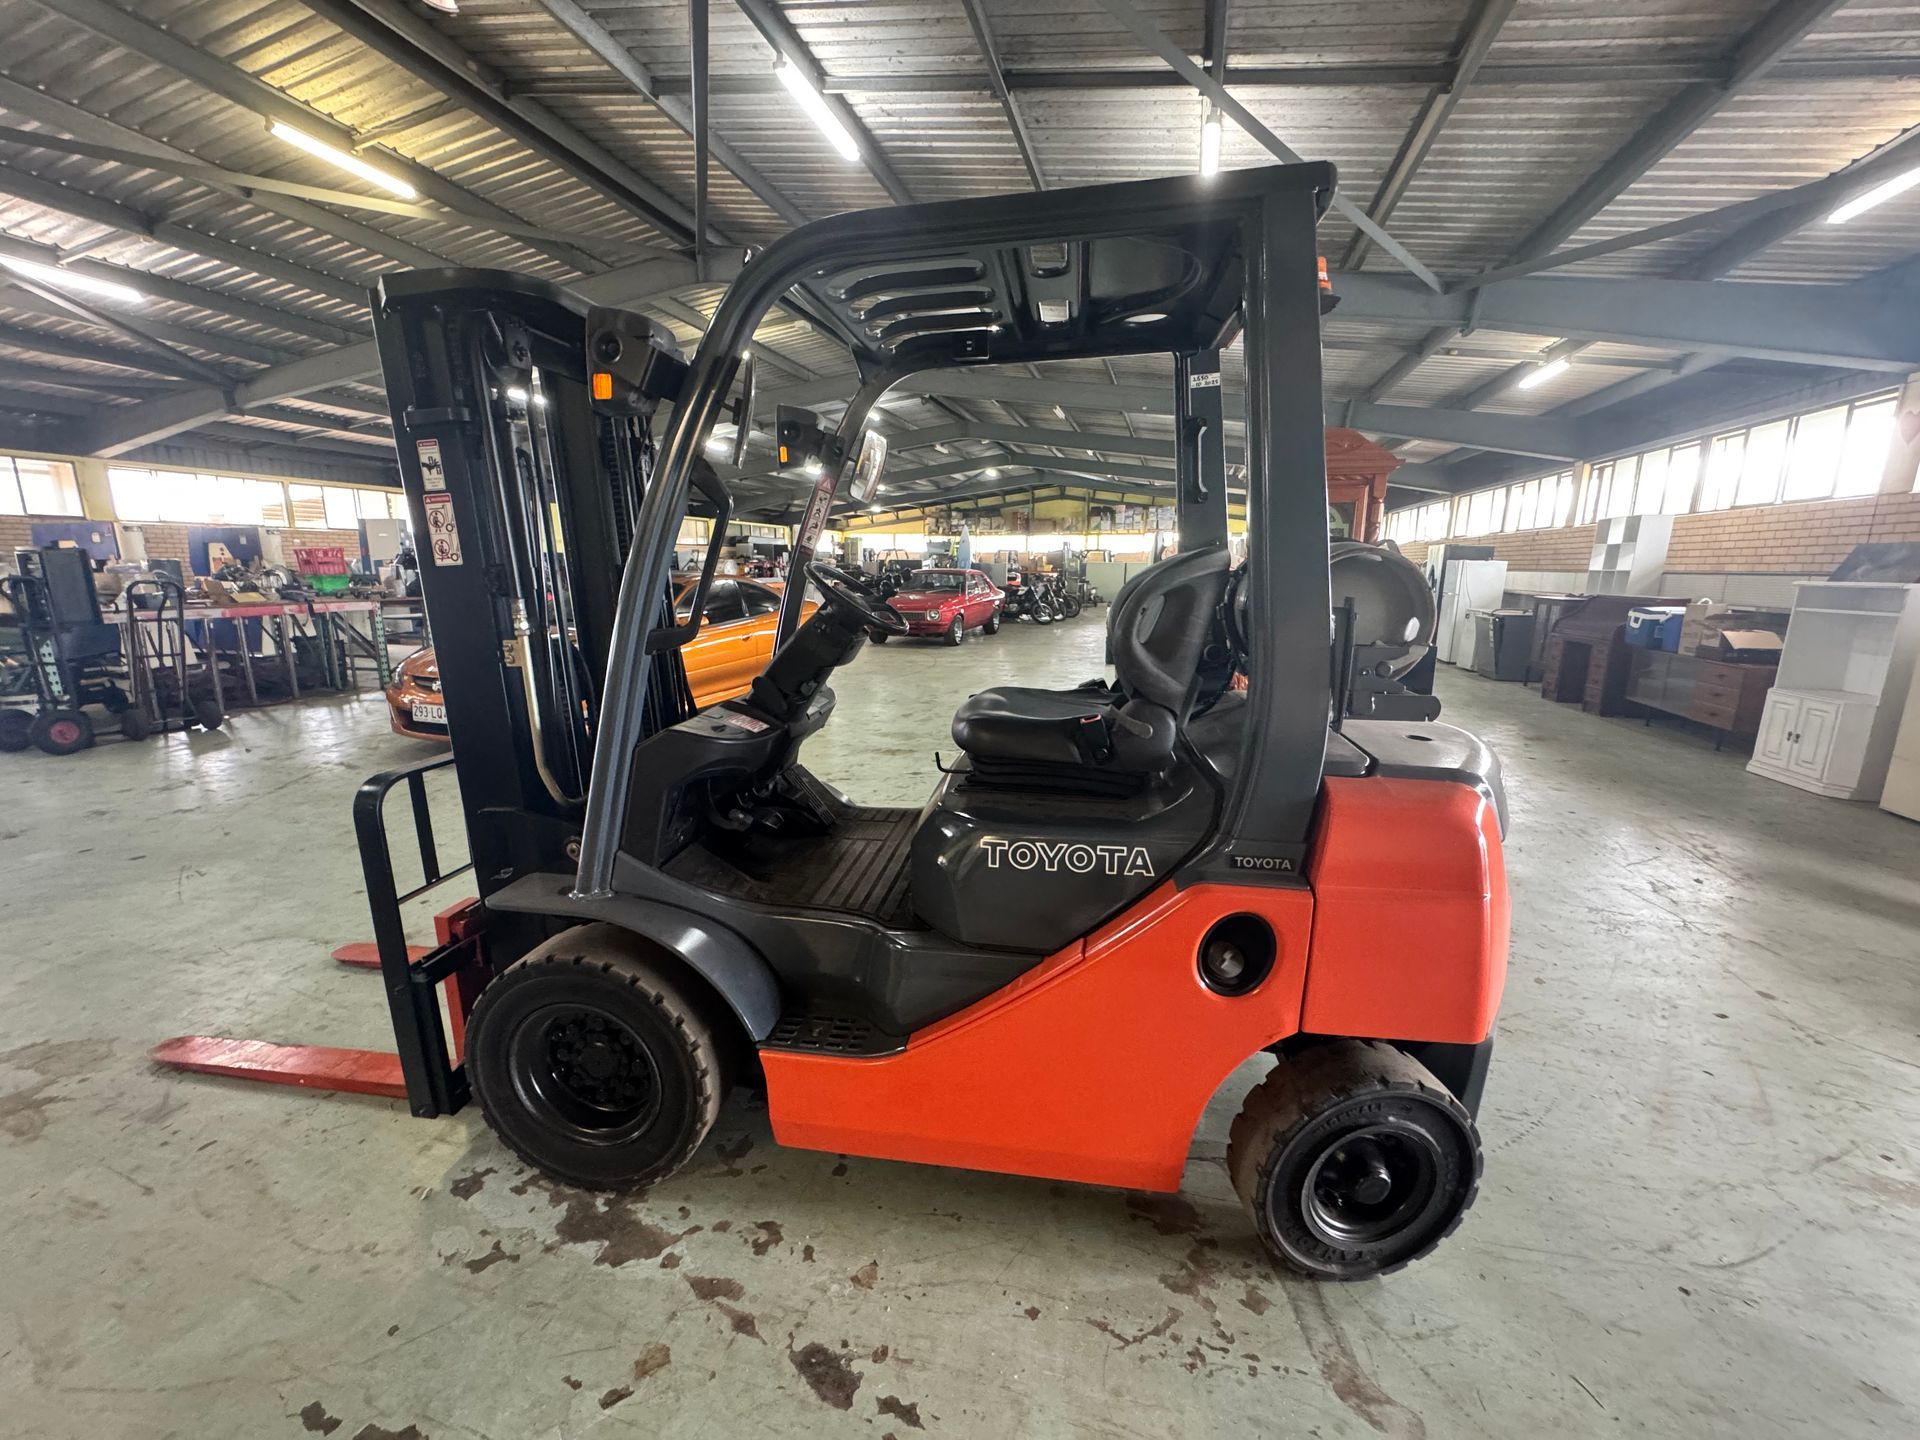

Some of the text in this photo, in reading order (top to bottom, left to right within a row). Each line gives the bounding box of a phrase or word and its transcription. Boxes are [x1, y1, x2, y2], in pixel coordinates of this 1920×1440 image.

[413, 705, 447, 719] 293 LQ
[980, 838, 1155, 876] TOYOTA
[1234, 856, 1292, 870] TOYOTA
